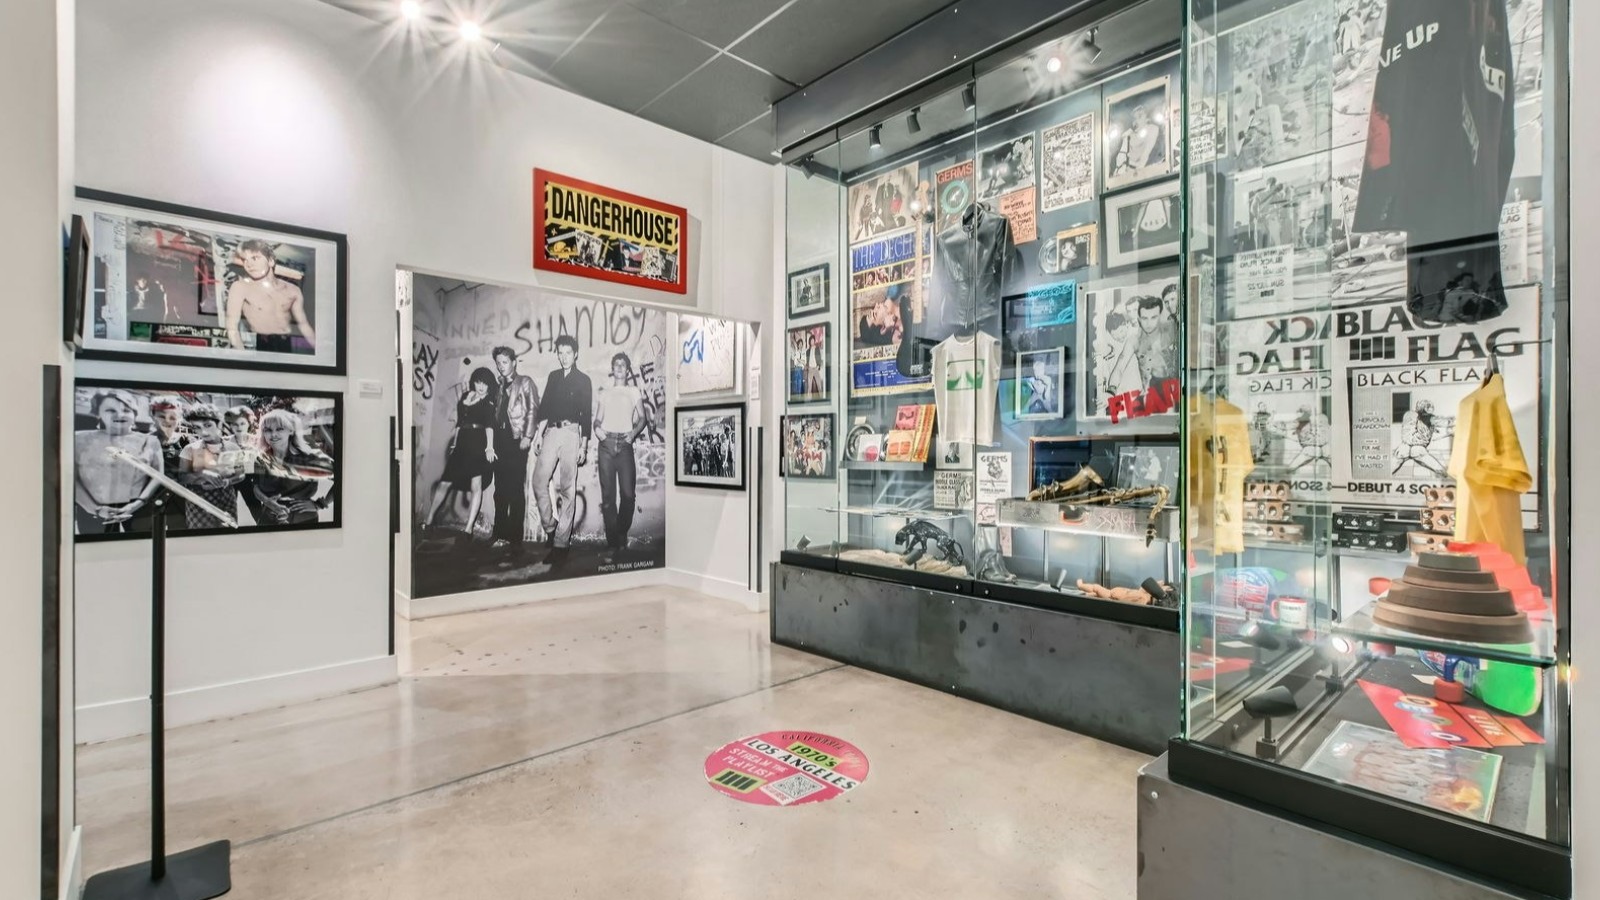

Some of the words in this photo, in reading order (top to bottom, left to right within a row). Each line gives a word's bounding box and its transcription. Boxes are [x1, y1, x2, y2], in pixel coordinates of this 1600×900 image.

[1405, 22, 1439, 50] UP
[938, 164, 973, 185] GERMS
[552, 186, 673, 246] DANGERHOUSE
[1408, 327, 1523, 363] FLAG
[1357, 370, 1427, 388] BLACK
[1347, 482, 1392, 494] DEBUT
[1395, 482, 1406, 494] 4
[617, 561, 634, 570] FRANK
[781, 733, 845, 750] CALIFORNIA
[723, 755, 777, 778] PLAYLIST
[729, 748, 772, 767] STREAM
[773, 763, 789, 773] THE
[747, 739, 776, 755] LOS
[779, 754, 859, 790] ANGELES
